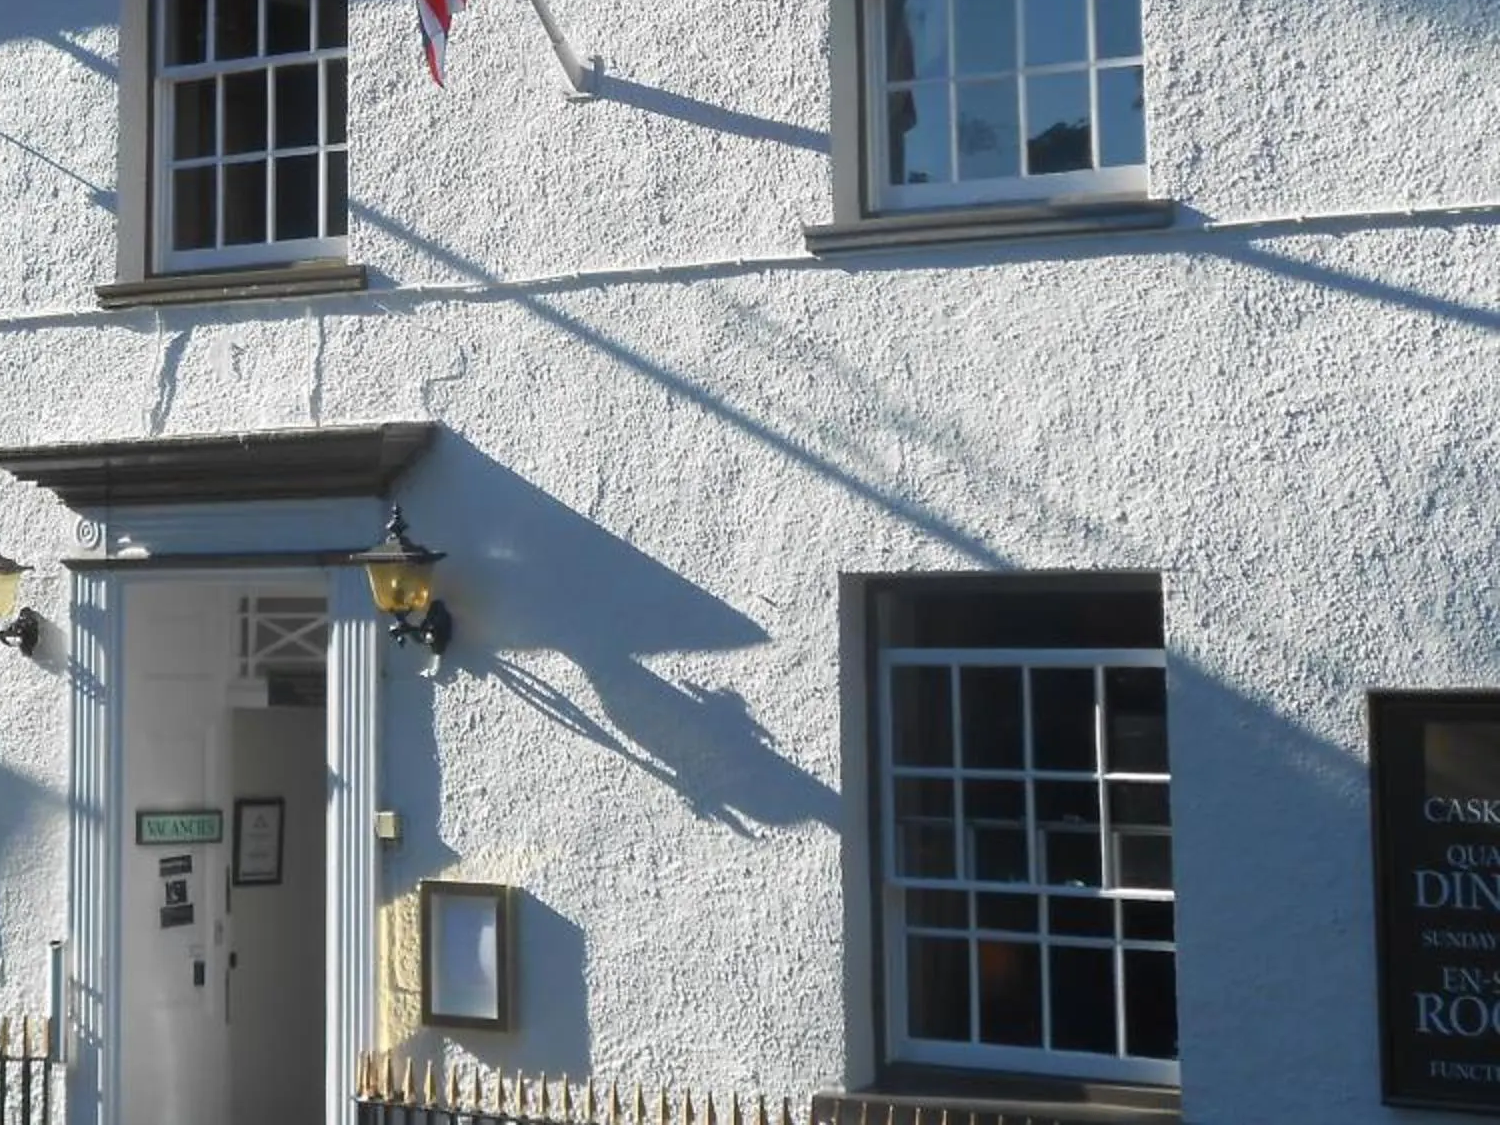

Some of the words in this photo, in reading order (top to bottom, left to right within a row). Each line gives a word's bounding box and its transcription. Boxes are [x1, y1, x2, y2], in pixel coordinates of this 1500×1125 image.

[1423, 796, 1500, 824] CASK
[147, 818, 216, 837] VACANCIES
[1422, 929, 1497, 951] SUNDAY
